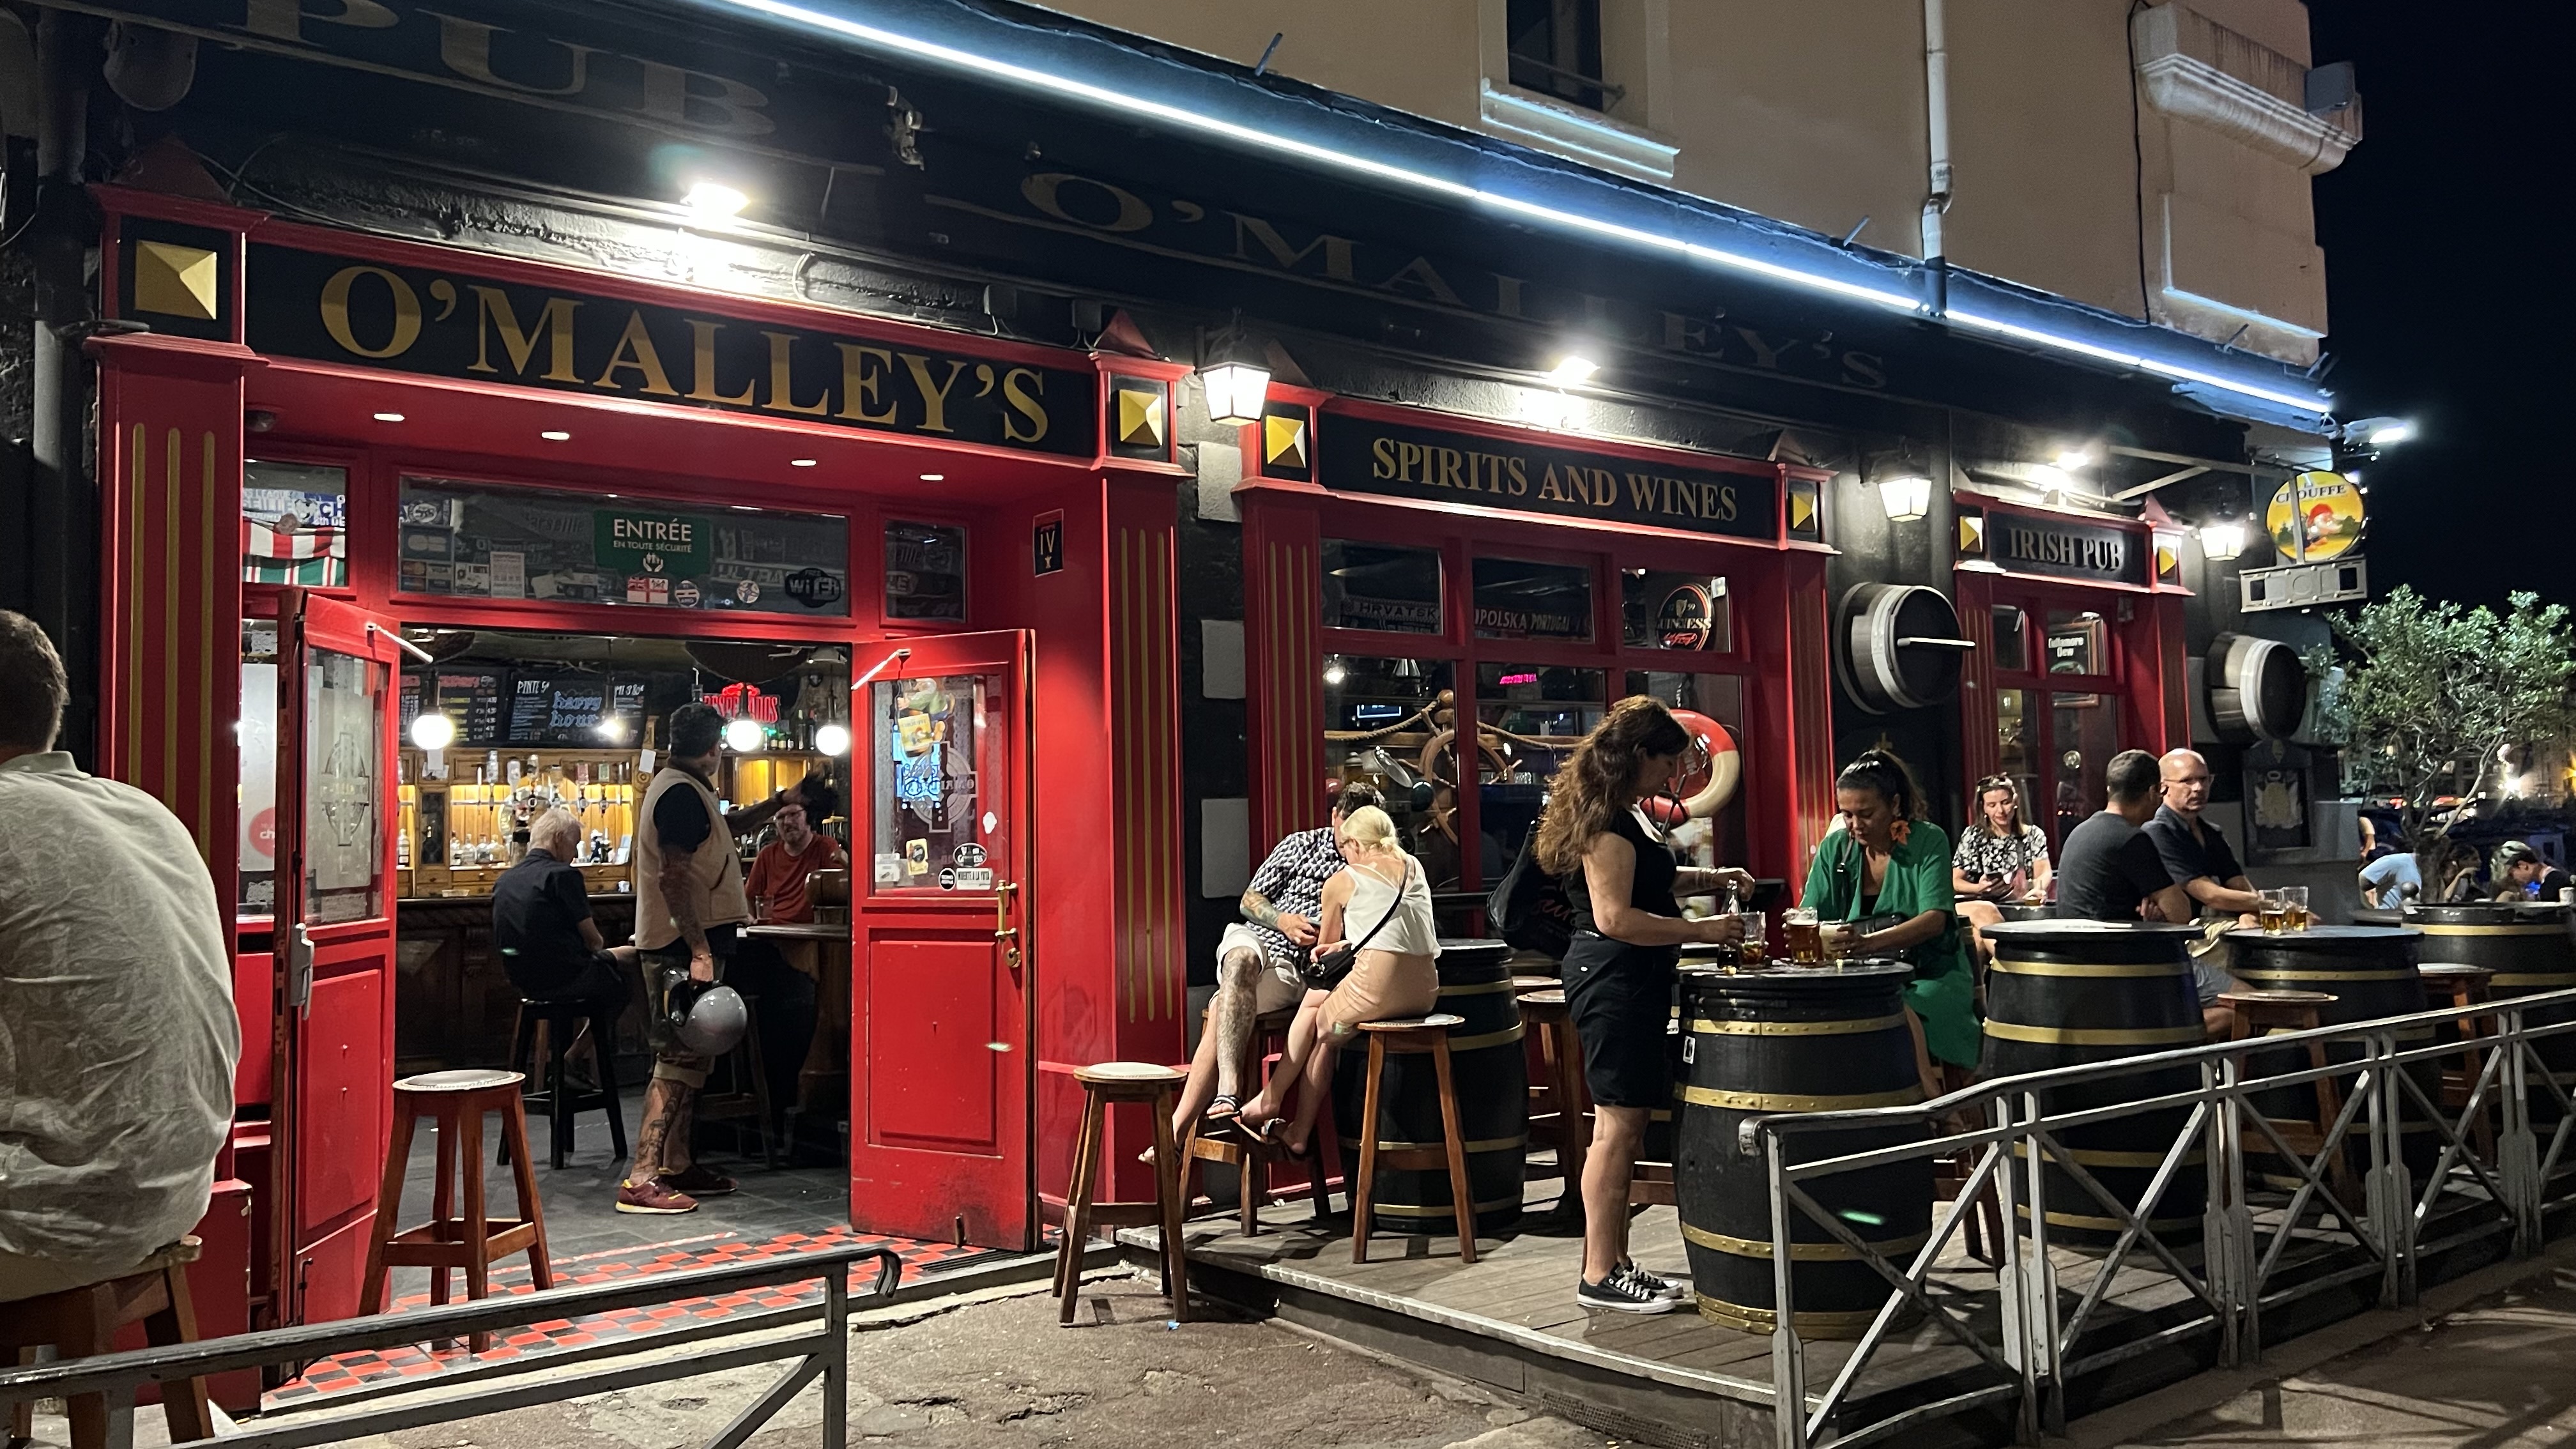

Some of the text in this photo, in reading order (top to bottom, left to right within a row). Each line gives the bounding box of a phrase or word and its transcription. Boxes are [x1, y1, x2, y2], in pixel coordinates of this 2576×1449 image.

[220, 0, 775, 134] PUB
[320, 265, 1048, 443] O'MALLEY'S
[1372, 437, 1737, 521] SPIRITS AND WINES
[613, 518, 692, 542] ENTRÉE
[628, 541, 654, 550] TOUTE
[656, 542, 692, 553] SÉCURITÉ
[1040, 530, 1055, 555] IV
[2010, 528, 2122, 571] IRISH PUB
[1359, 602, 1440, 619] HRVATSK
